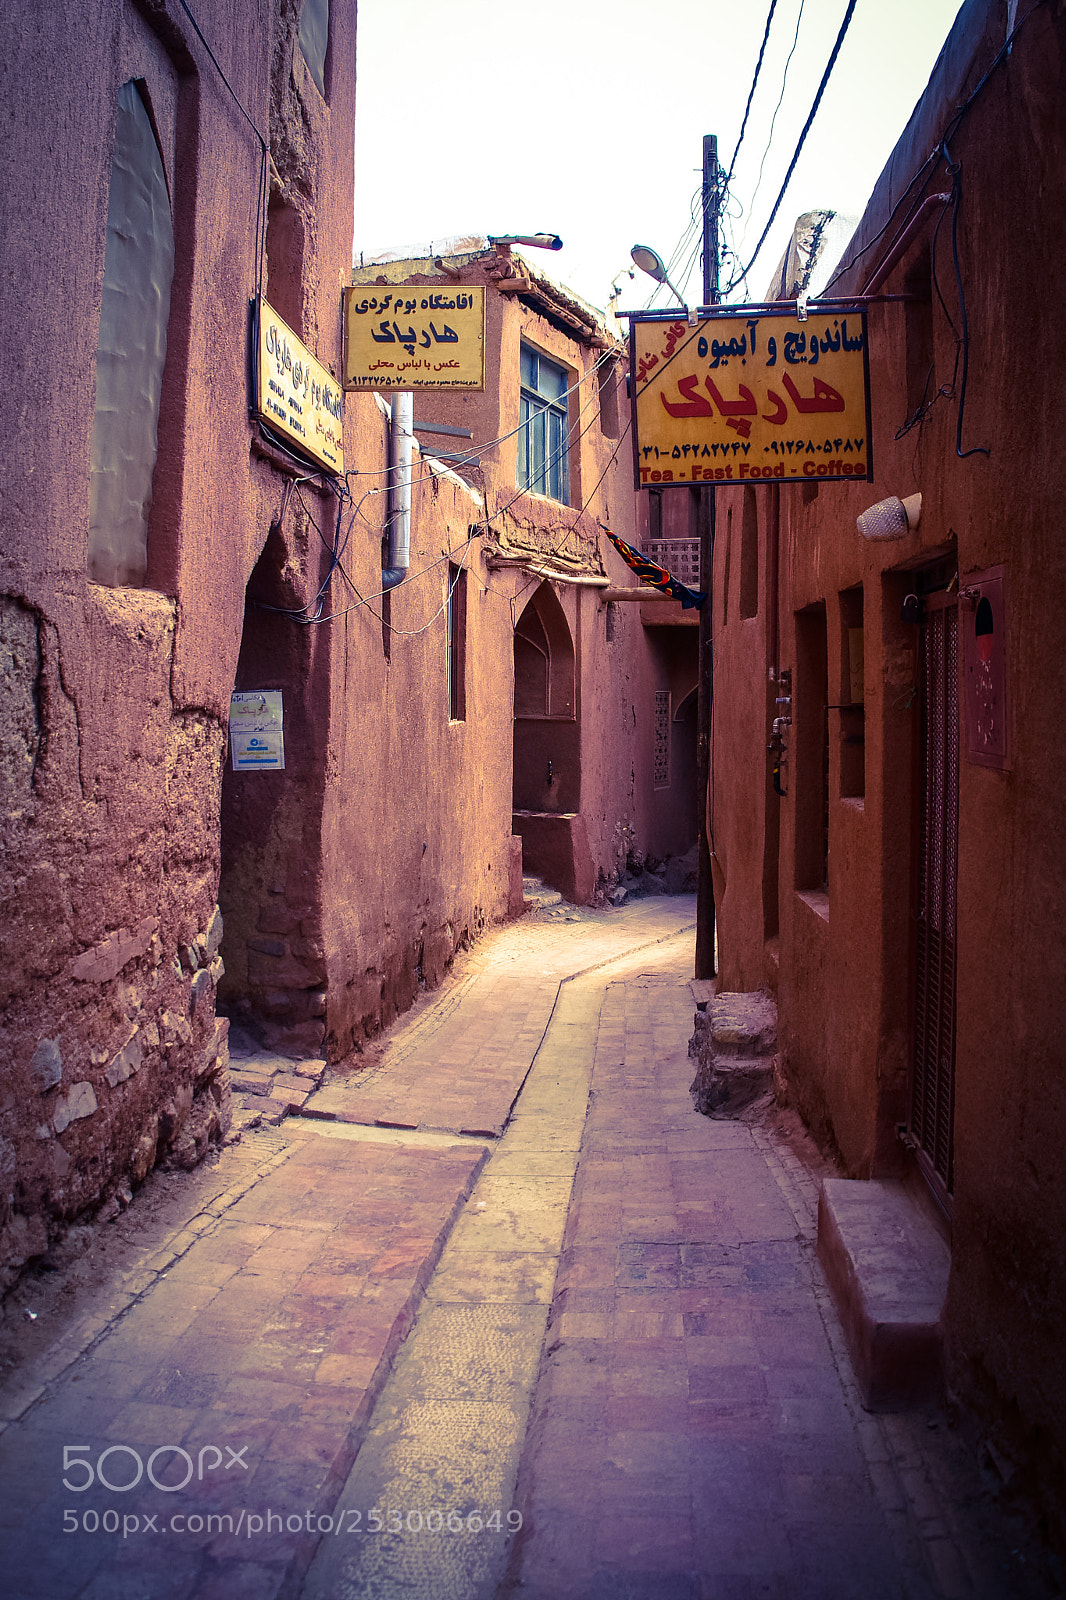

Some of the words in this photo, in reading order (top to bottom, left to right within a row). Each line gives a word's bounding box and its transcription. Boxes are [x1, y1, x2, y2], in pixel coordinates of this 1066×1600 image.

[355, 294, 392, 314] گردی
[394, 298, 416, 315] بوم
[421, 293, 473, 310] اقامتگاه
[371, 320, 458, 356] هارپاک
[661, 320, 686, 358] کافی
[698, 319, 759, 369] آبمیوه
[784, 319, 864, 365] ساندویچ
[766, 336, 777, 366] و
[368, 360, 394, 370] محلی
[397, 360, 422, 372] لباس
[424, 360, 430, 370] با
[434, 360, 460, 372] عکس
[636, 352, 659, 383] شاپ
[660, 371, 845, 438] هارپاک
[763, 438, 864, 455] ۰۹۱۲۶۸۰۵۴۸۷
[639, 466, 674, 482] Tea
[692, 464, 732, 480] Fast
[739, 462, 784, 478] Food
[802, 460, 866, 476] Coffee
